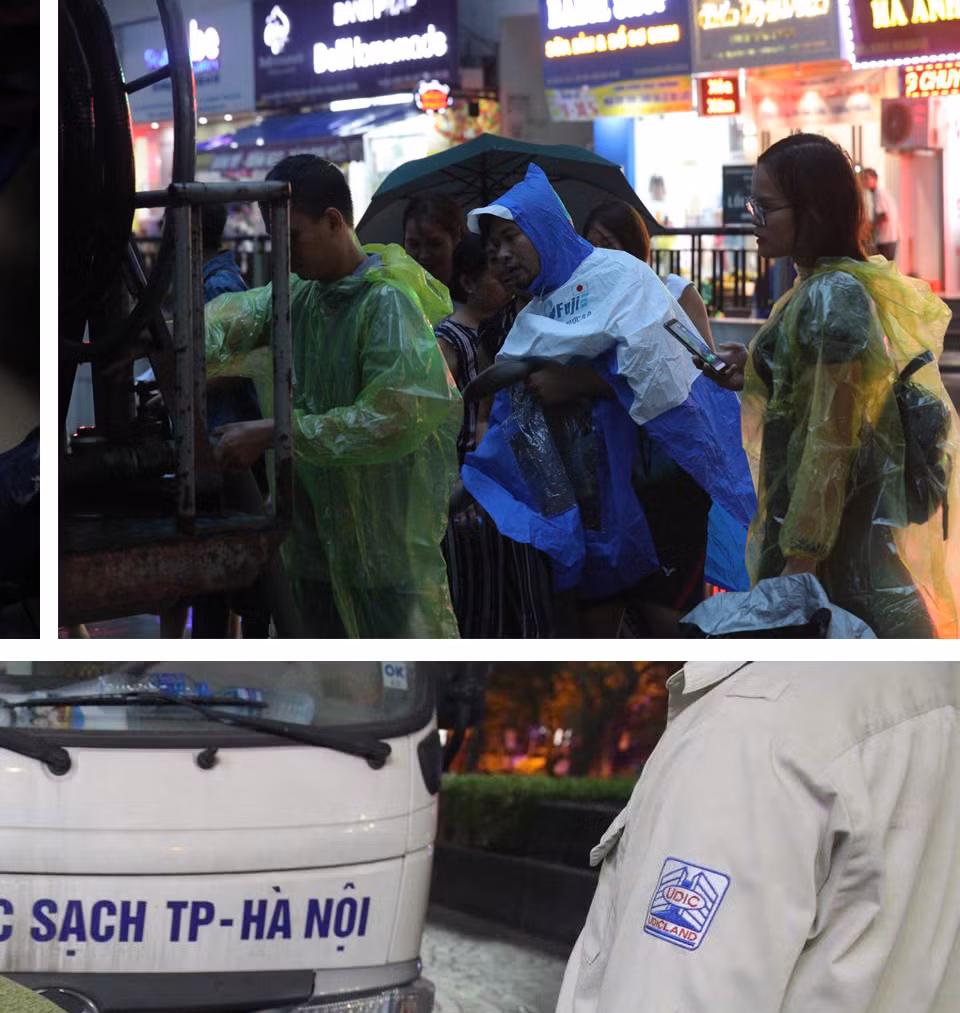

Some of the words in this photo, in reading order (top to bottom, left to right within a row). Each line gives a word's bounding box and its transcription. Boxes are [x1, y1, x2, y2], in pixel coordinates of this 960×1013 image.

[385, 663, 405, 679] OK
[666, 887, 701, 908] UDIC
[30, 898, 147, 956] SẠCH
[304, 882, 371, 952] NỘI
